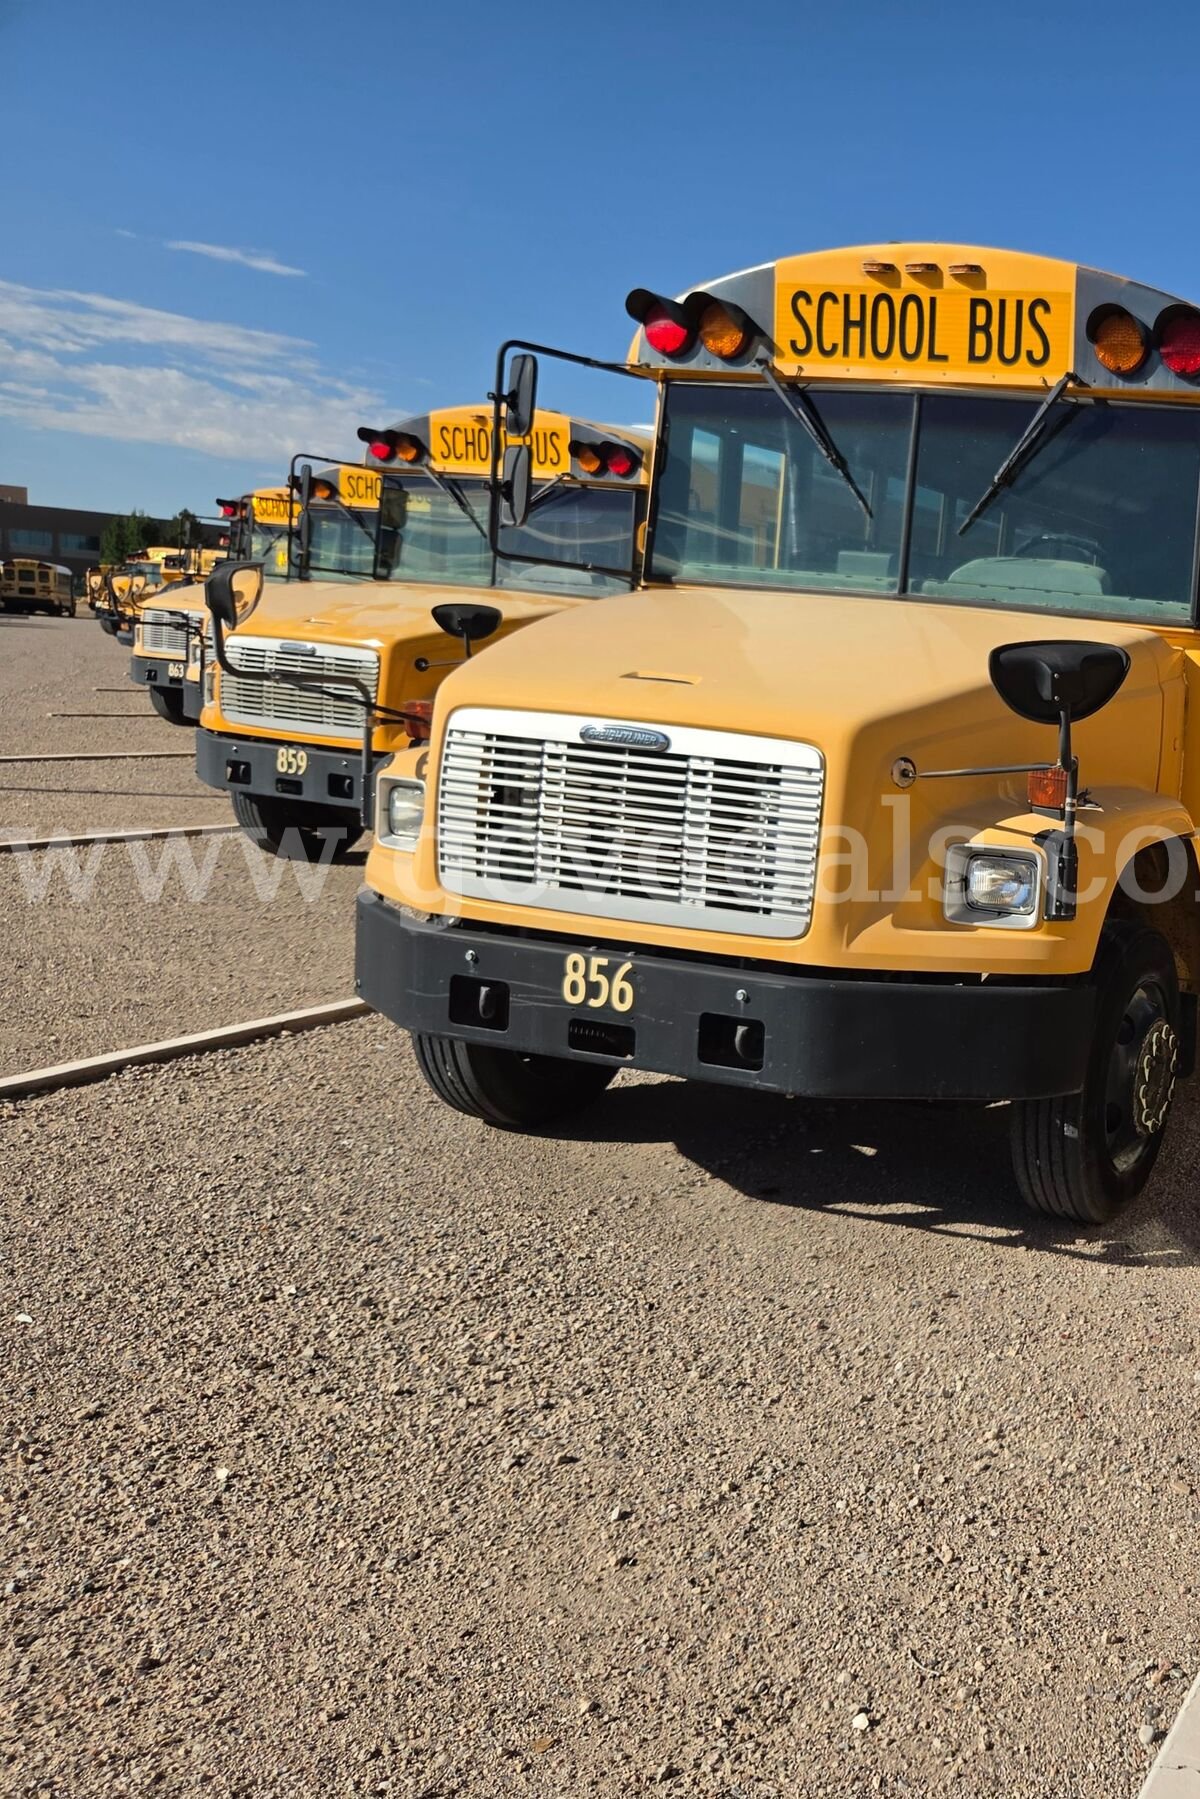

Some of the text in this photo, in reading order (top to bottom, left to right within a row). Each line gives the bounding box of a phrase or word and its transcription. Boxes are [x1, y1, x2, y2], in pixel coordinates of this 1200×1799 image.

[789, 289, 1053, 368] SCHOOL BUS
[440, 426, 507, 462] SCHO
[347, 475, 384, 501] SCHO
[168, 663, 184, 678] 863
[589, 728, 658, 746] FREIGHTLINER
[276, 746, 308, 776] 859
[563, 952, 634, 1012] 856
